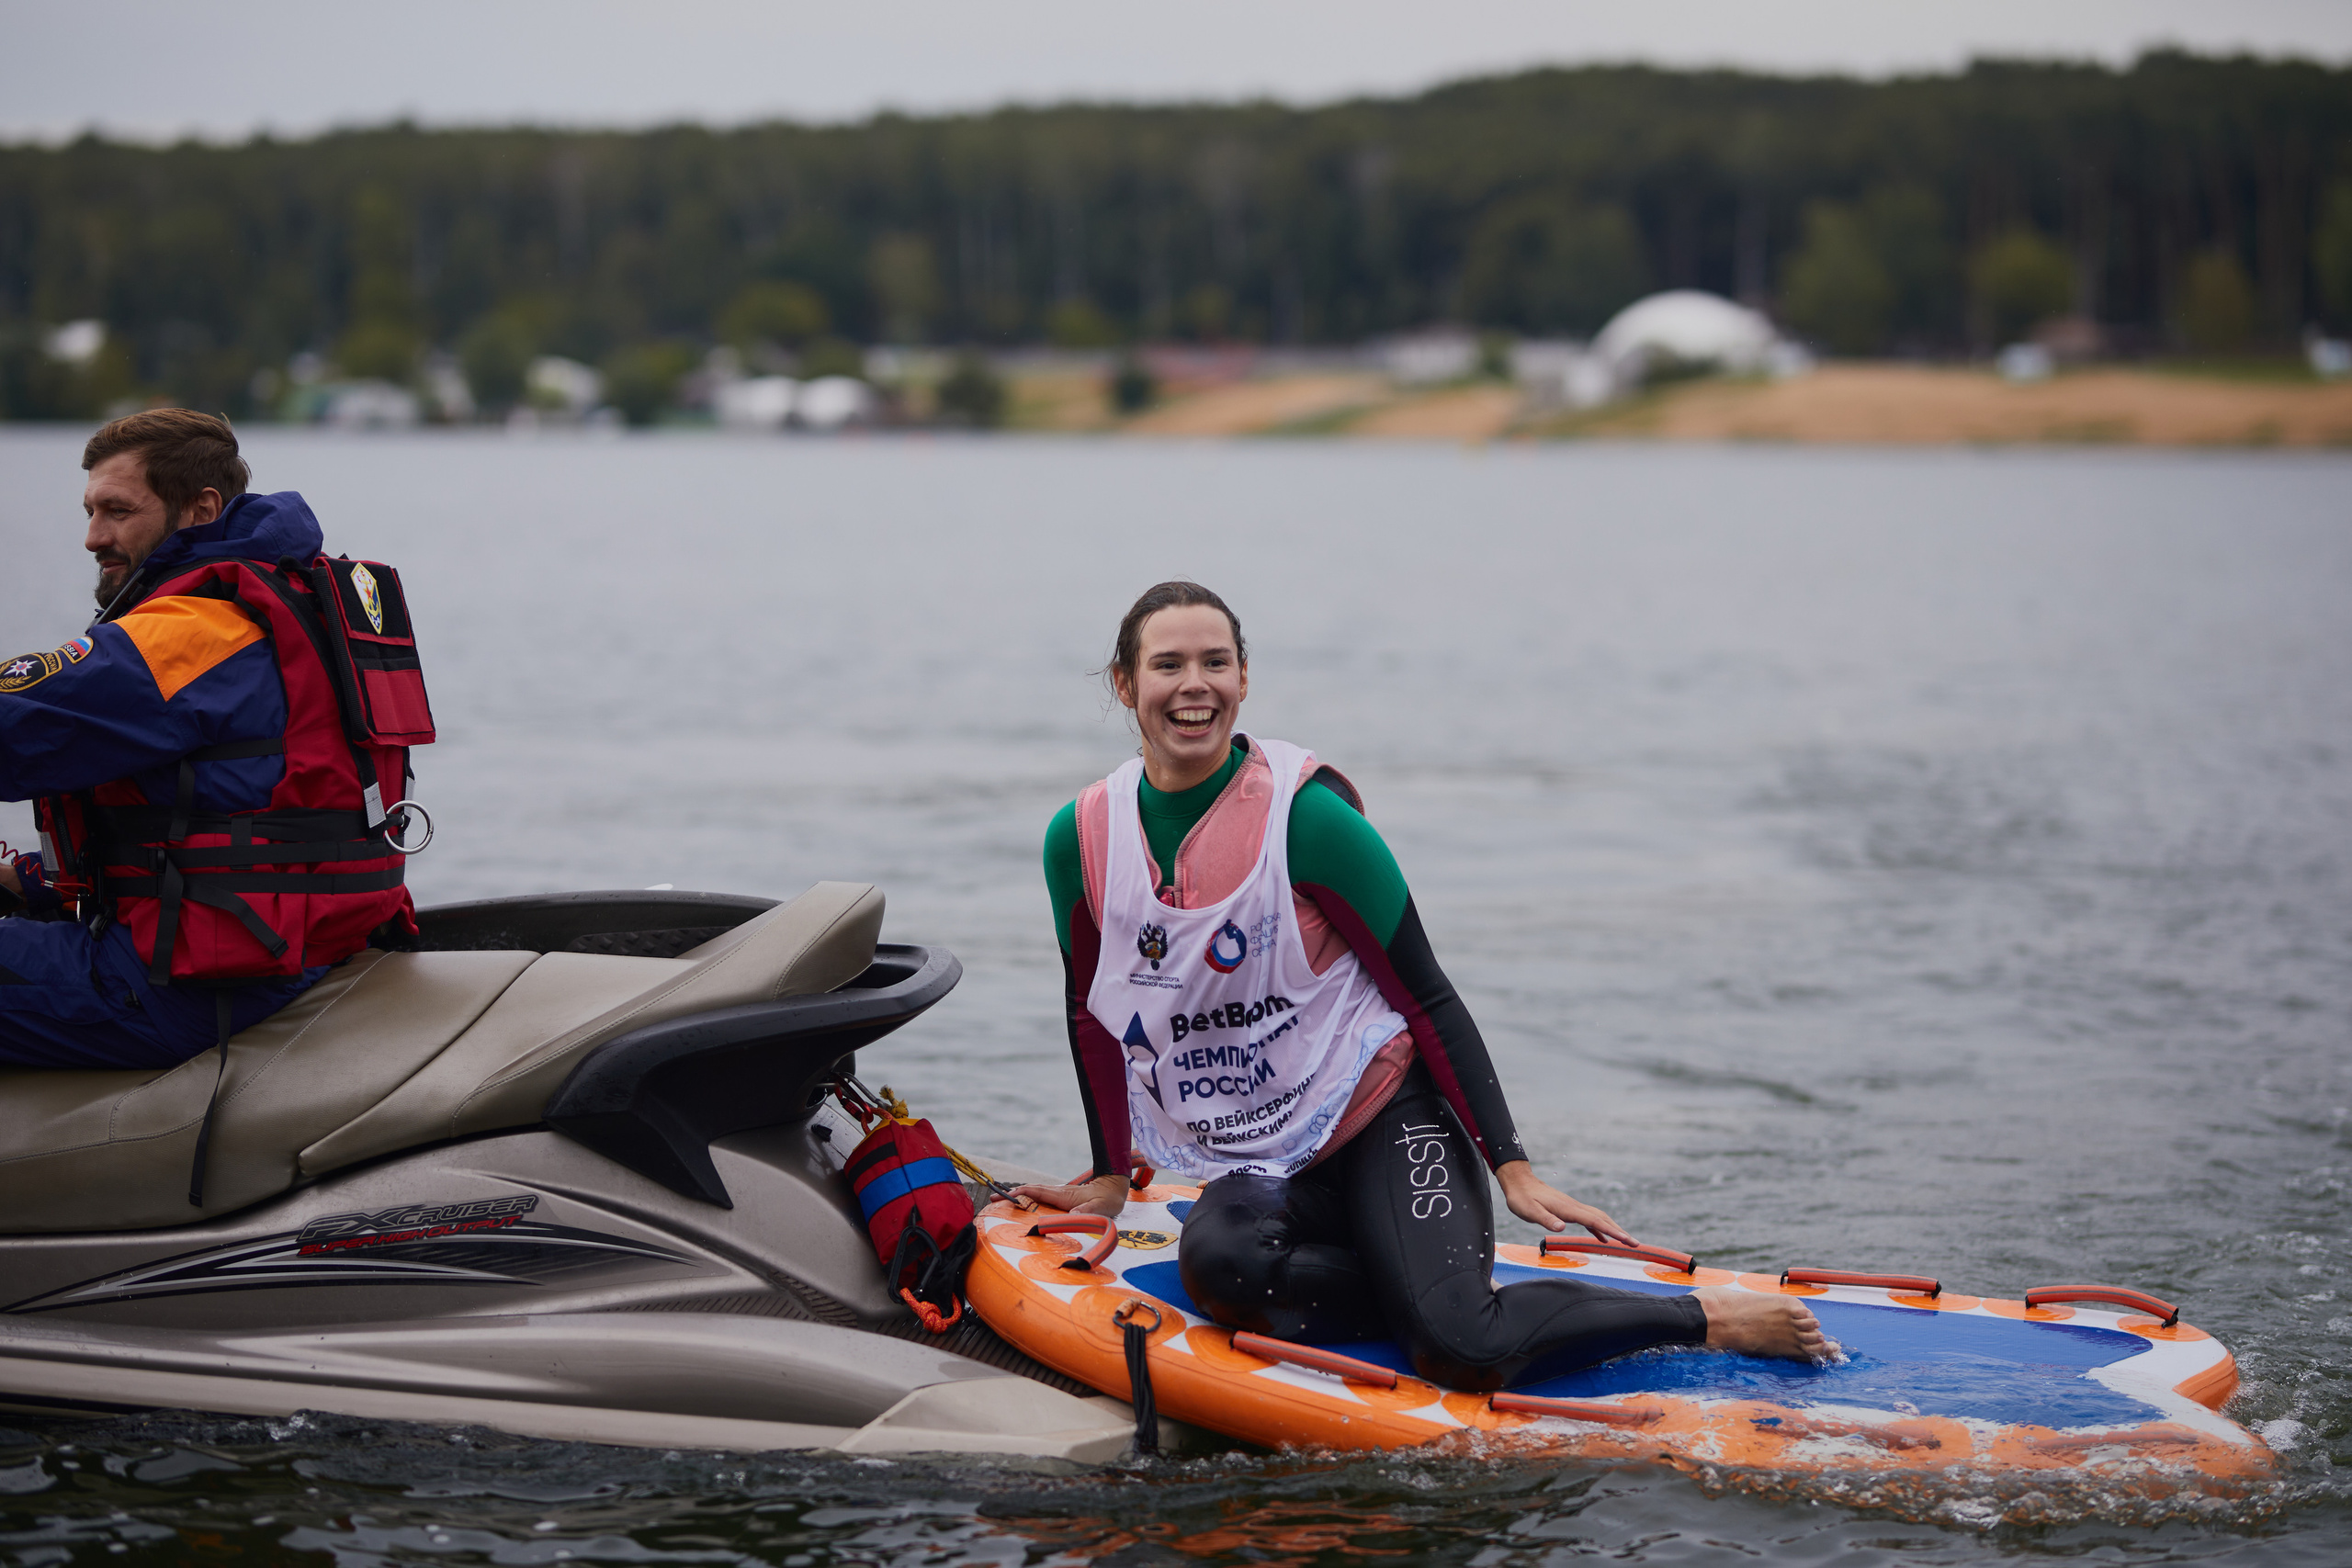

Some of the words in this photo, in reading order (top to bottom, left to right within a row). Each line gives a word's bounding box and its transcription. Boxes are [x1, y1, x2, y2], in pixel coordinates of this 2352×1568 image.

[1214, 1072, 1317, 1131] ВЕЙКСЕРФИН
[295, 1204, 426, 1242] FX
[396, 1195, 539, 1226] CRUISER
[299, 1233, 376, 1256] SUPER
